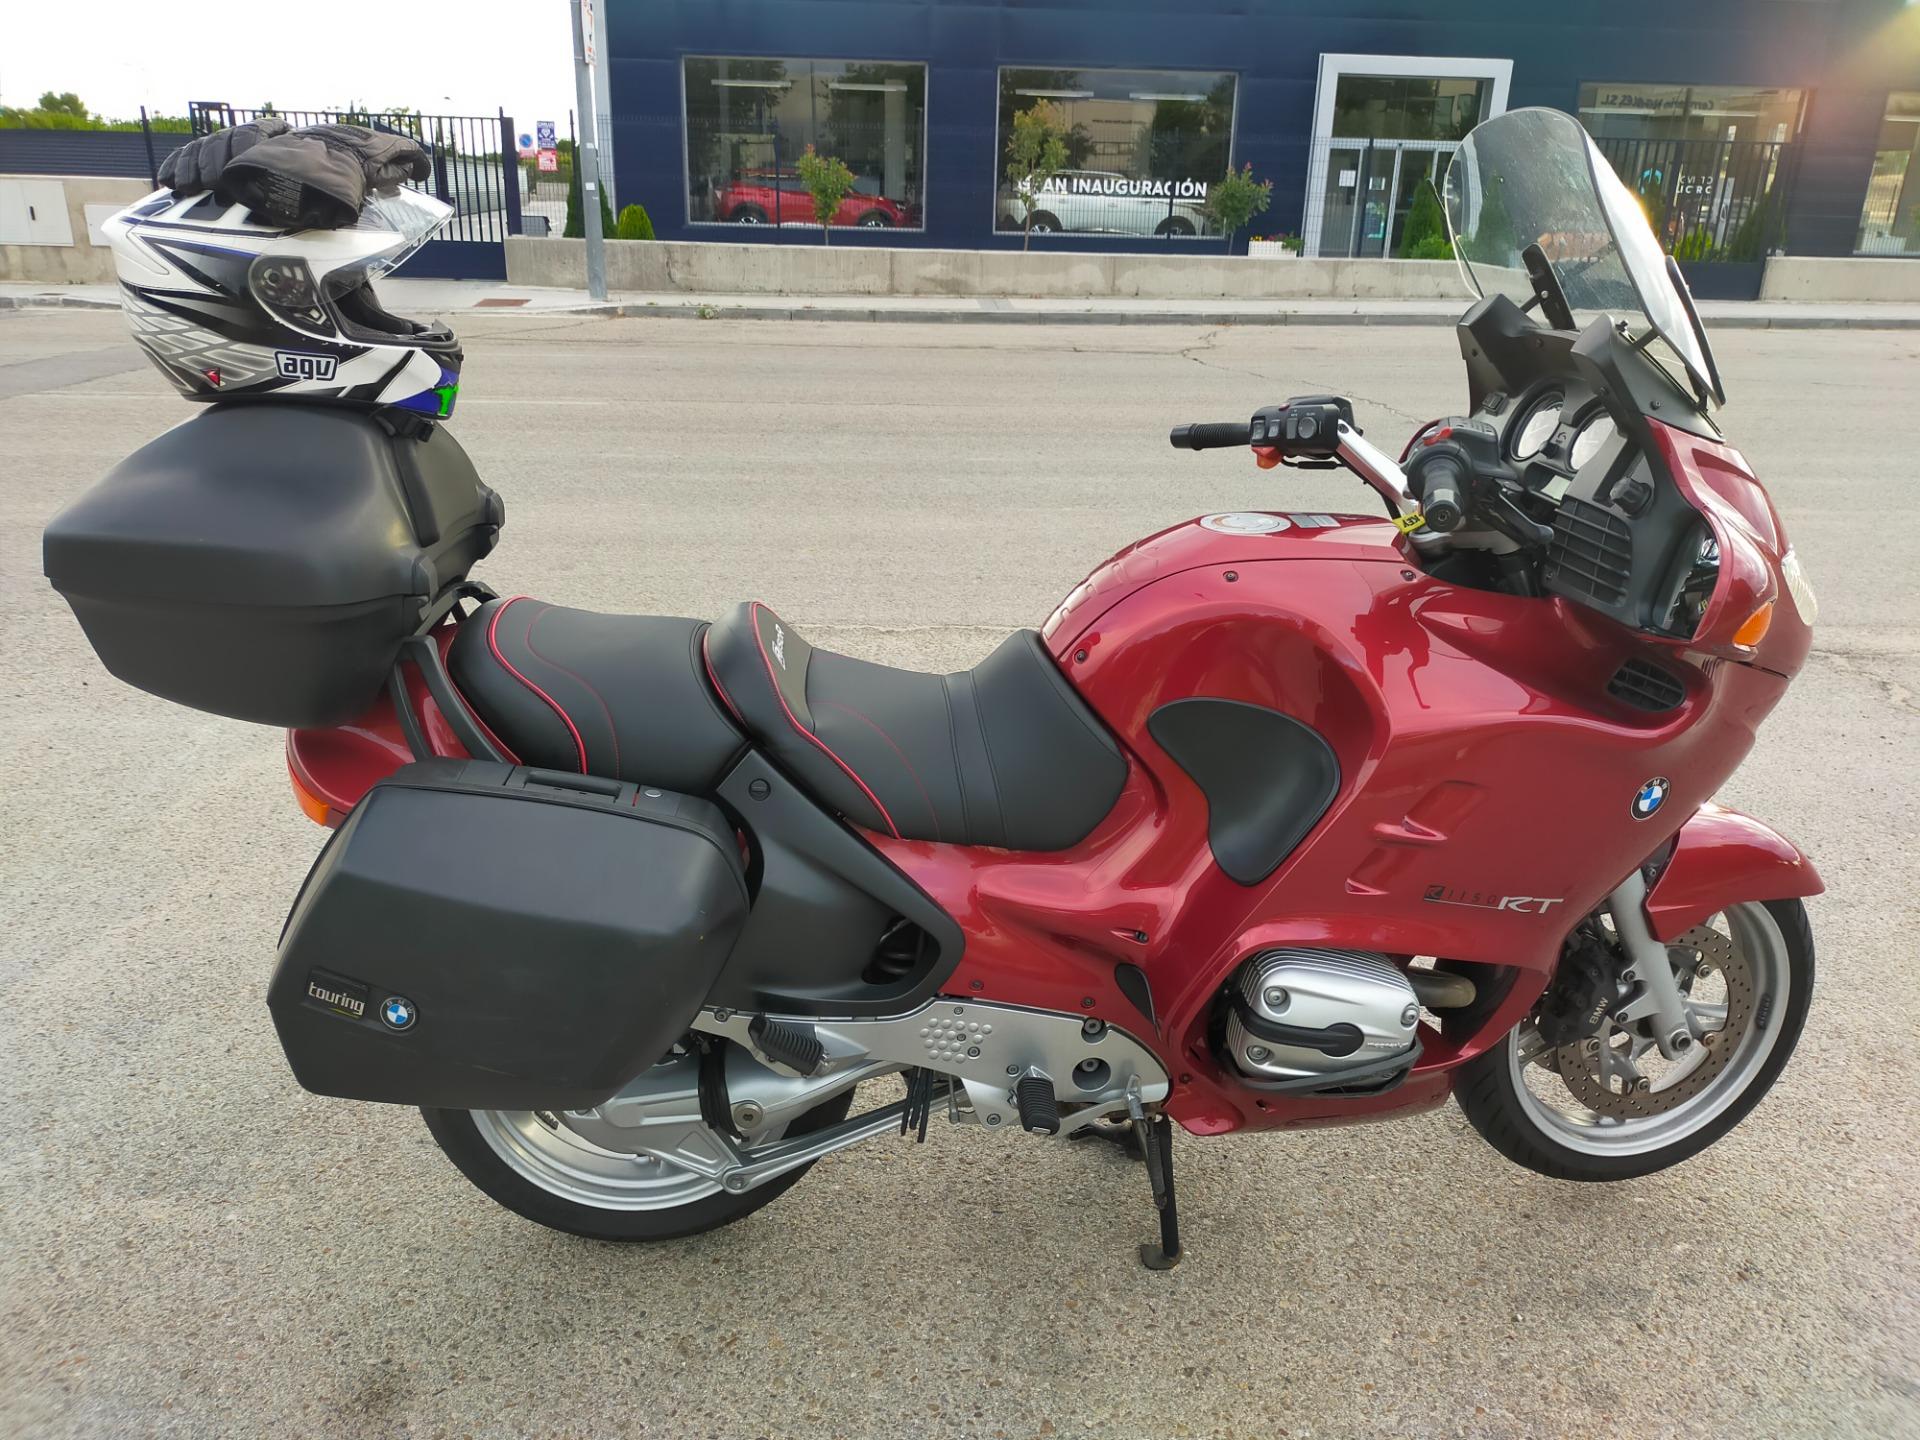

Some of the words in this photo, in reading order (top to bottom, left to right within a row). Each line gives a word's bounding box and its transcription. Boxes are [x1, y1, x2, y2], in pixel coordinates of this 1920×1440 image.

[1072, 177, 1208, 198] INAUGURACIÓN
[283, 356, 331, 380] agv
[308, 981, 365, 1016] touring
[1589, 998, 1609, 1024] BMW
